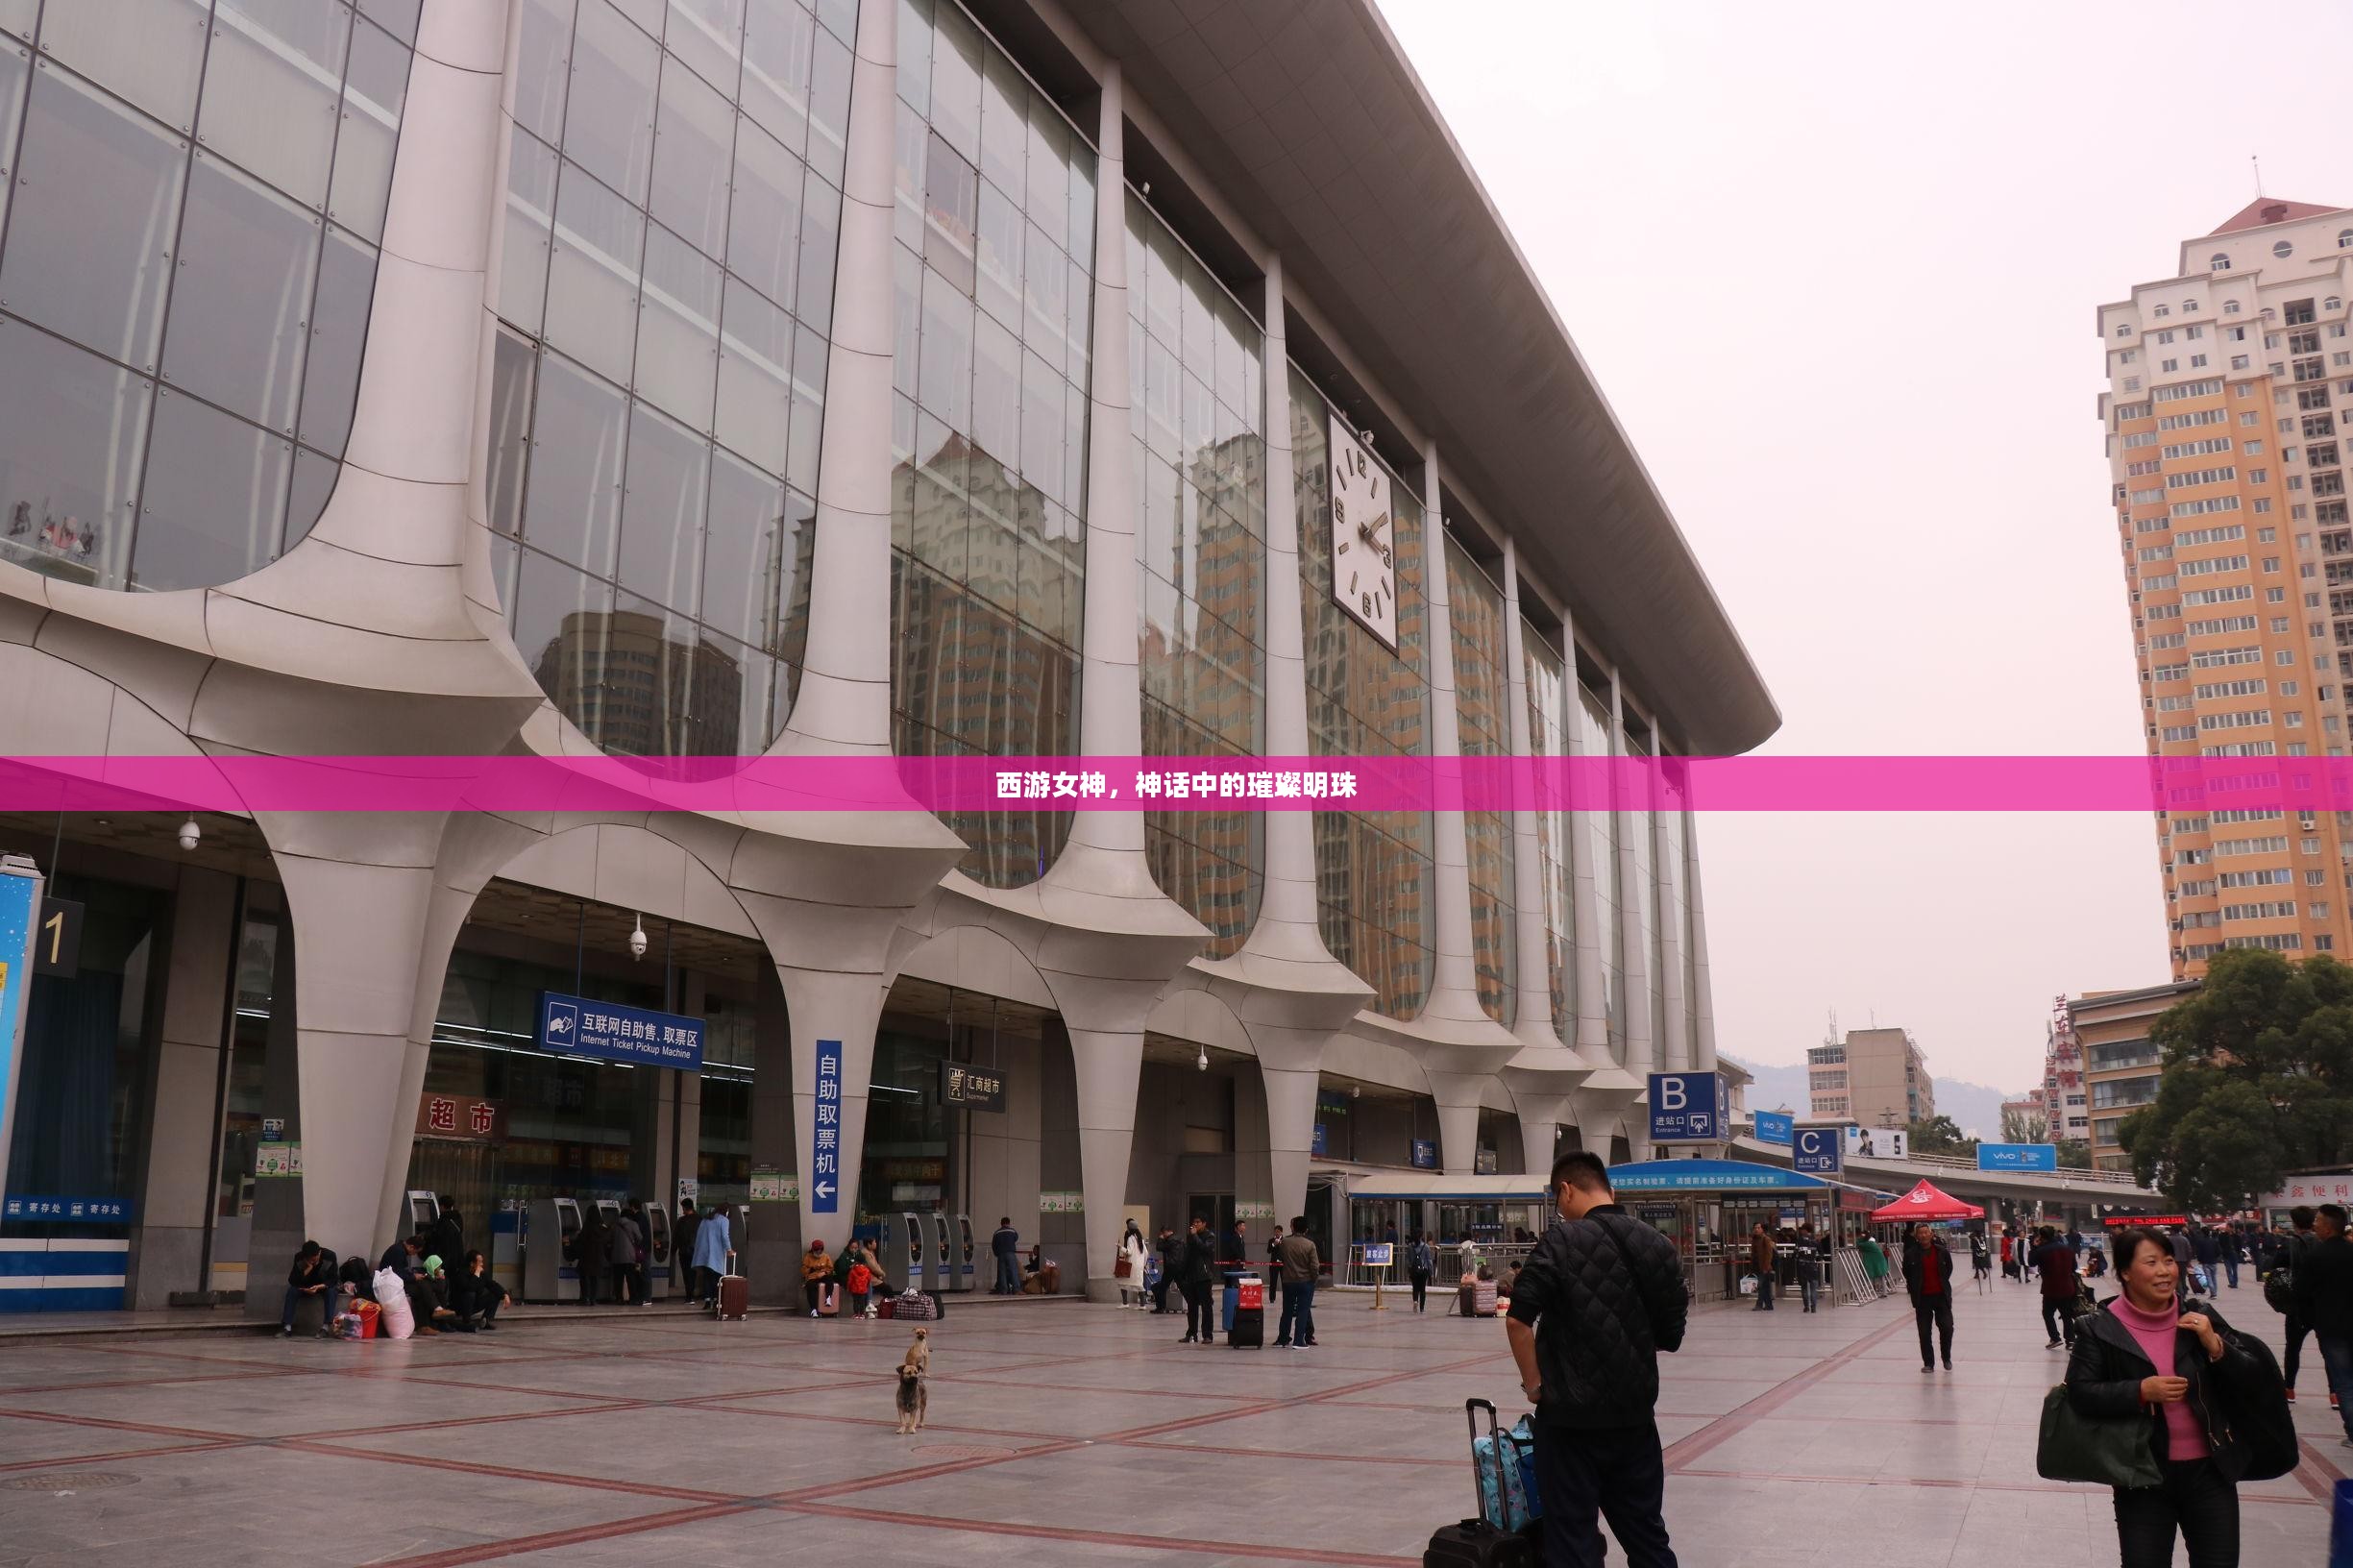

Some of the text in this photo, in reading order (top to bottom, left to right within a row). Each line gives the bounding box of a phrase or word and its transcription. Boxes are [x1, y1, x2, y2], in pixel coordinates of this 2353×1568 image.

[45, 912, 63, 964] 1
[581, 1013, 699, 1047] 互联网自助售、取票区
[580, 1033, 691, 1059] Internet Ticket Pickup Machine
[967, 1075, 1000, 1093] 汇商超市
[1661, 1077, 1687, 1110] B
[429, 1097, 495, 1134] 超市
[817, 1055, 838, 1173] 自助取票机
[1655, 1115, 1684, 1126] 进站口
[1762, 1121, 1775, 1130] vivo
[1801, 1131, 1820, 1154] C
[29, 1202, 61, 1213] 寄存处
[90, 1204, 120, 1214] 寄存处
